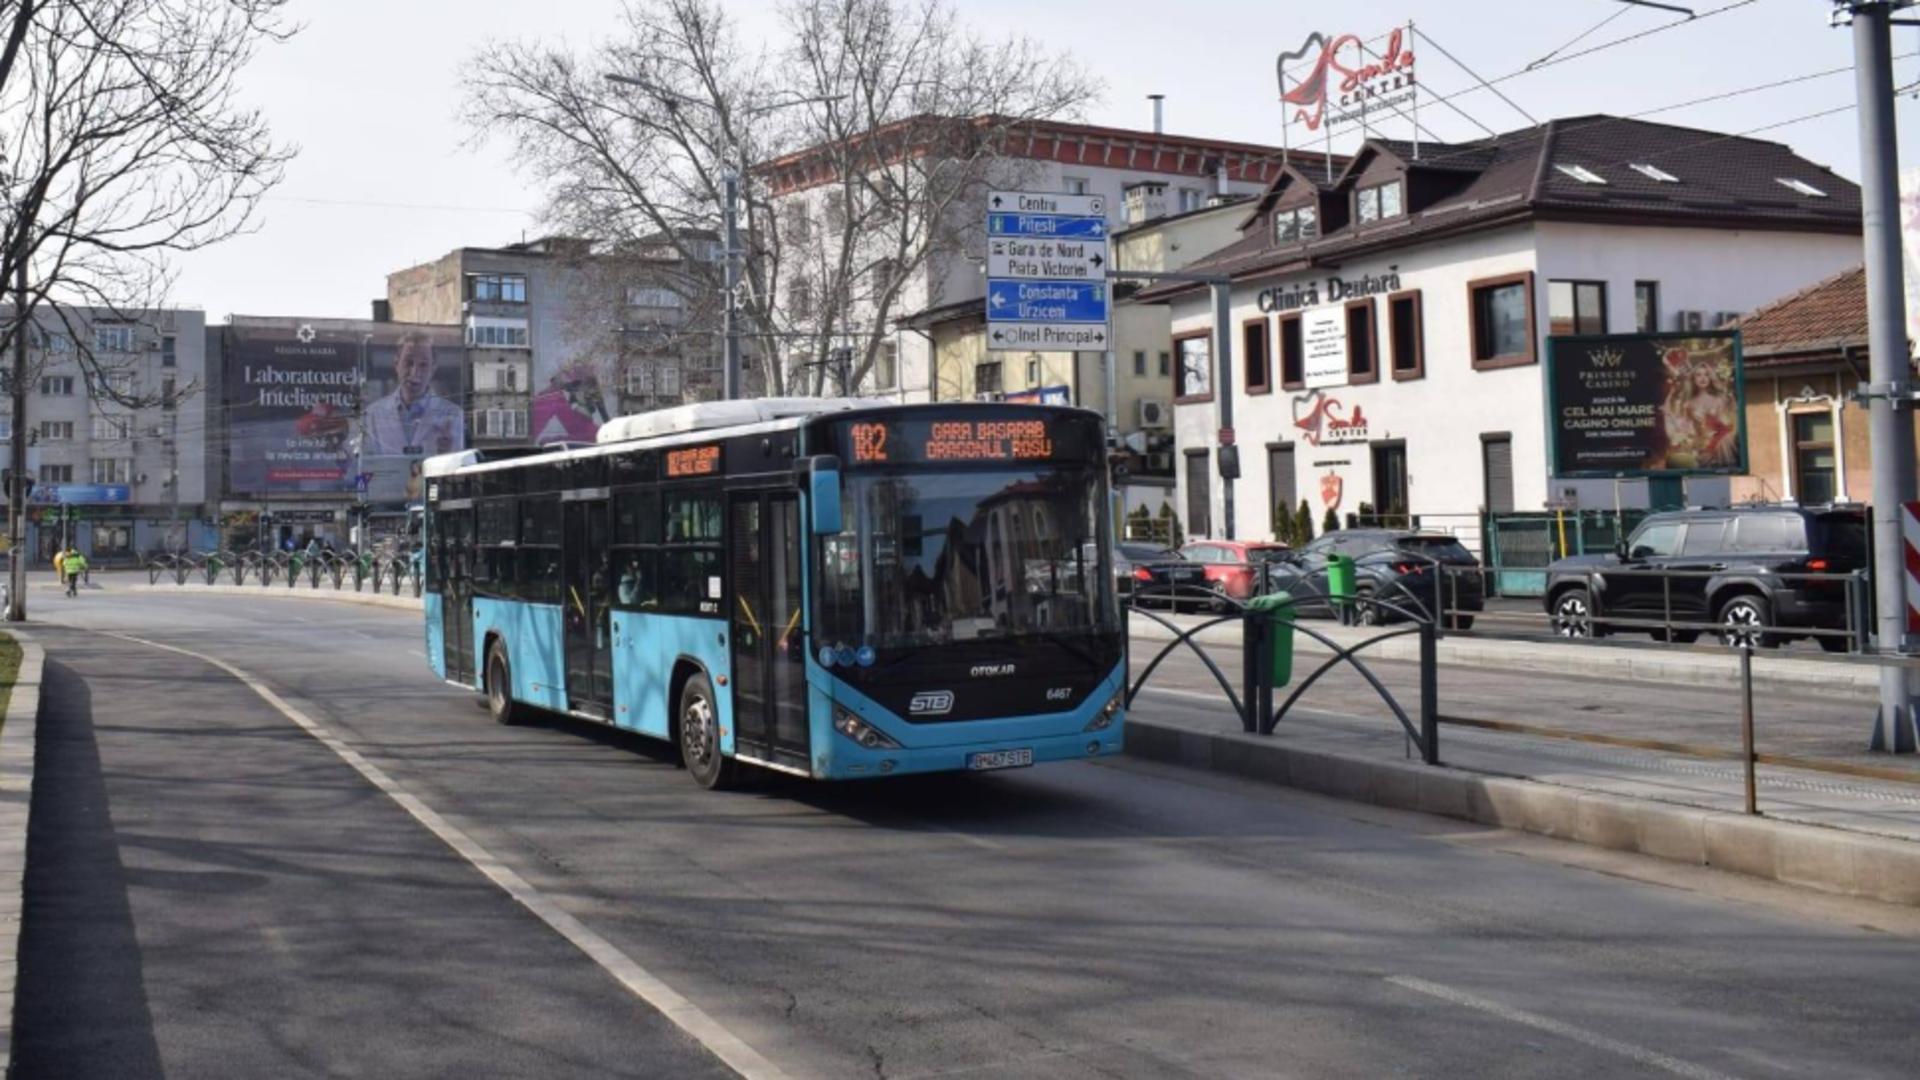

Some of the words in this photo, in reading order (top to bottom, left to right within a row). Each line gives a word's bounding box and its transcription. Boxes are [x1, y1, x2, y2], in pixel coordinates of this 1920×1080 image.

[1018, 195, 1057, 212] Centru
[1008, 240, 1035, 256] Gara
[1040, 242, 1053, 258] de
[1056, 242, 1084, 258] Nord
[1041, 260, 1088, 277] Victoriei
[1258, 281, 1320, 313] Clinică
[1326, 264, 1402, 302] Dentară
[1018, 302, 1067, 319] Urziceni
[1018, 327, 1040, 342] Inel
[1044, 327, 1094, 347] Principal
[259, 386, 354, 411] Inteligente
[1563, 407, 1588, 417] CEL
[1590, 406, 1615, 416] MAI
[1617, 405, 1655, 415] MARE
[932, 422, 971, 440] GARA
[977, 421, 1044, 440] BASARAB
[1563, 418, 1609, 430] CASINO
[1611, 417, 1656, 428] ONLINE
[926, 440, 1007, 458] DRAGONUL
[1012, 438, 1051, 457] ROSU
[970, 663, 1015, 677] OTOKAR
[1046, 687, 1072, 700] 6467
[909, 694, 950, 711] STB
